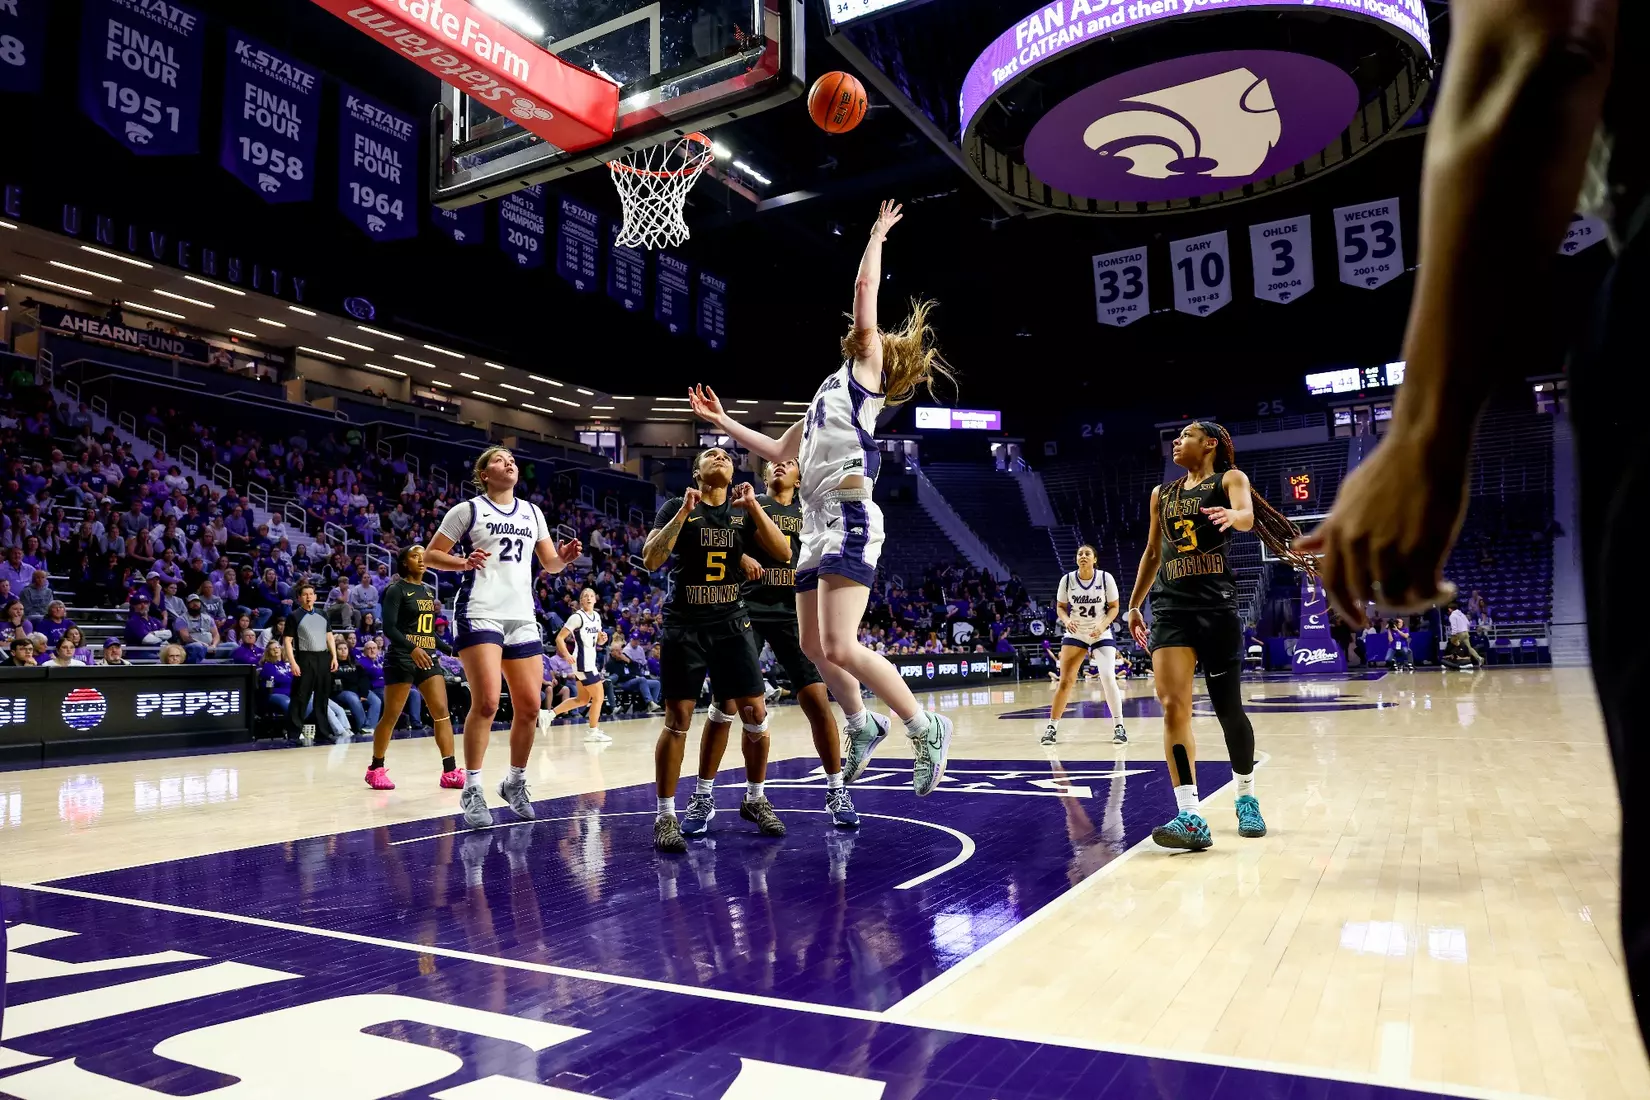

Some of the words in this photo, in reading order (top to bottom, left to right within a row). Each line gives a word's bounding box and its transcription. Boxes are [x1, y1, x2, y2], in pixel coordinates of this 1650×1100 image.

[836, 3, 848, 14] 34
[1014, 2, 1064, 50] FAN
[107, 18, 180, 70] FINAL
[347, 6, 516, 102] StateFarm
[991, 56, 1019, 86] Text
[1019, 21, 1083, 66] CATFAN
[1087, 6, 1125, 34] and
[1128, 0, 1178, 20] then
[106, 39, 177, 89] FOUR
[234, 39, 315, 90] K-STATE
[240, 56, 264, 73] MEN'S
[265, 69, 309, 95] BASKETBALL
[102, 80, 180, 134] 1951
[245, 82, 302, 125] FINAL
[345, 95, 413, 137] K-STATE
[833, 91, 851, 125] ELITE
[243, 101, 300, 142] FOUR
[238, 136, 304, 181] 1958
[354, 132, 403, 170] FINAL
[354, 150, 401, 185] FOUR
[349, 182, 404, 221] 1964
[502, 200, 544, 224] CONFERENCE
[511, 194, 525, 207] BIG
[525, 201, 534, 211] 12
[562, 199, 598, 224] K-STATE
[1344, 206, 1389, 222] WECKER
[501, 208, 545, 235] CHAMPIONS
[1263, 224, 1298, 238] OHLDE
[61, 201, 308, 303] UNIVERSITY
[507, 227, 538, 252] 2019
[1185, 240, 1212, 253] GARY
[1344, 220, 1396, 263] 53
[659, 252, 689, 273] K-STATE
[1097, 253, 1142, 268] ROMSTAD
[1270, 239, 1295, 276] 3
[1353, 264, 1390, 276] 2001-05
[700, 272, 727, 291] K-STATE
[1098, 265, 1143, 304] 33
[1177, 252, 1224, 292] 10
[1267, 279, 1302, 291] 2000-04
[1106, 304, 1137, 315] 1979-82
[1187, 292, 1220, 305] 1981-83
[1338, 377, 1353, 386] 44
[1257, 399, 1286, 416] 25
[1081, 422, 1104, 437] 24
[1290, 474, 1310, 485] 6:45
[1294, 484, 1309, 499] 15
[486, 522, 532, 538] Wildcats
[700, 527, 735, 548] WEST
[1174, 520, 1198, 553] 3
[499, 537, 524, 563] 23
[706, 552, 727, 581] 5
[760, 568, 797, 587] VIRGI
[1166, 553, 1223, 580] VIRGINIA
[1071, 595, 1102, 604] Wildcats
[1079, 605, 1097, 618] 24
[417, 613, 433, 634] 10
[970, 662, 988, 673] PEPSI
[1294, 648, 1338, 665] Dillons
[900, 665, 923, 677] PEPSI
[939, 664, 958, 675] PEPSI
[136, 690, 240, 718] PEPSI
